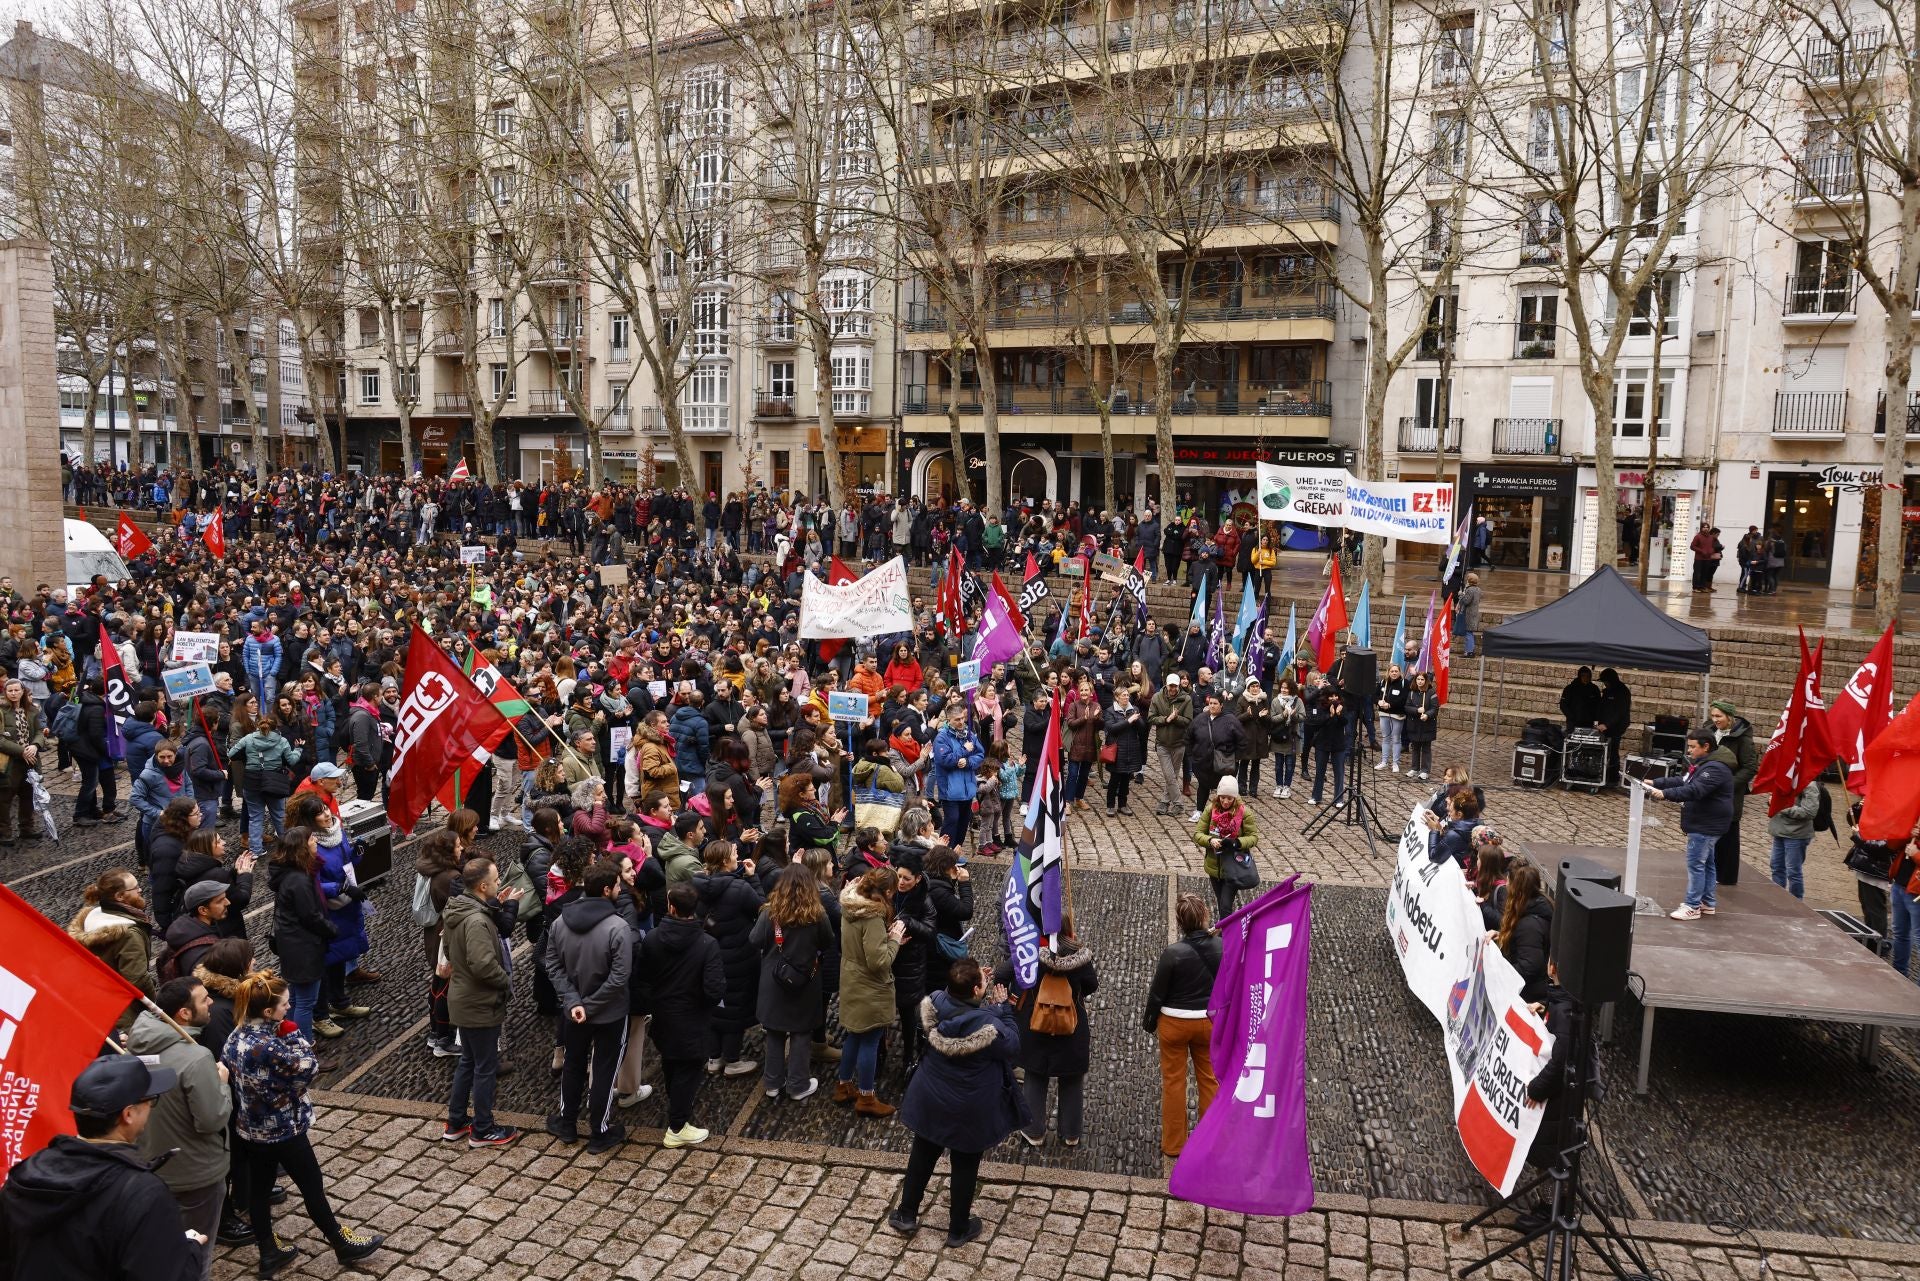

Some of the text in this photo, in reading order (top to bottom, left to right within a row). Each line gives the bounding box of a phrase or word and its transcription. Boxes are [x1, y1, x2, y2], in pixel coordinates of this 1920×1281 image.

[1223, 449, 1272, 461] JUEGO
[1278, 451, 1336, 462] FUEROS
[1295, 477, 1317, 485] UHEI
[1324, 478, 1343, 487] IVED
[1492, 477, 1557, 486] FARMACIA FUEROS
[1307, 493, 1326, 501] ERE
[1294, 500, 1343, 516] GREBAN
[1419, 517, 1445, 530] ALDE
[1403, 879, 1445, 960] hobetu.
[1005, 876, 1039, 985] steilas
